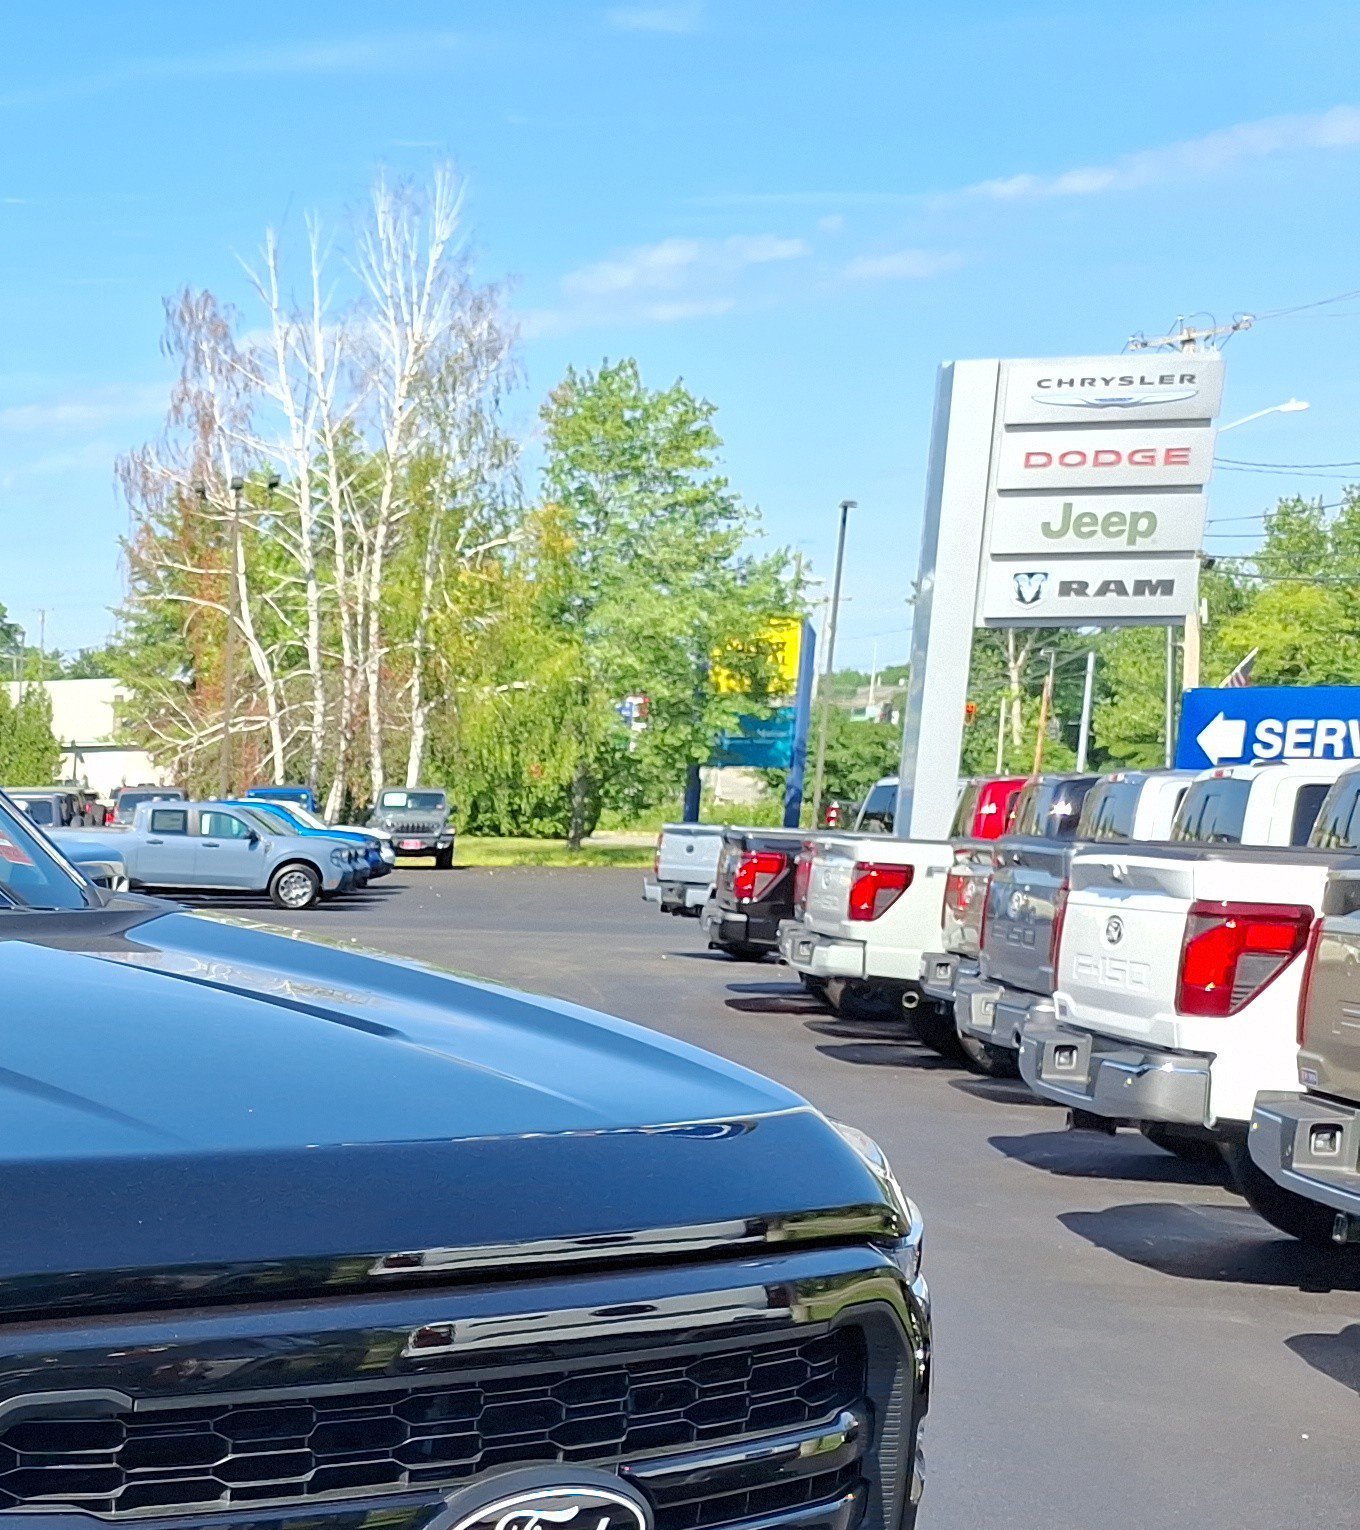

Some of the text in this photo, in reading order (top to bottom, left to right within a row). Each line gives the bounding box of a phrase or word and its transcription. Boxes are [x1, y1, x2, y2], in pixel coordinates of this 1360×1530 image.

[1036, 373, 1198, 389] CHRYSLER
[1023, 447, 1192, 469] DODGE
[1040, 502, 1158, 546] Jeep
[1057, 578, 1176, 598] RAM
